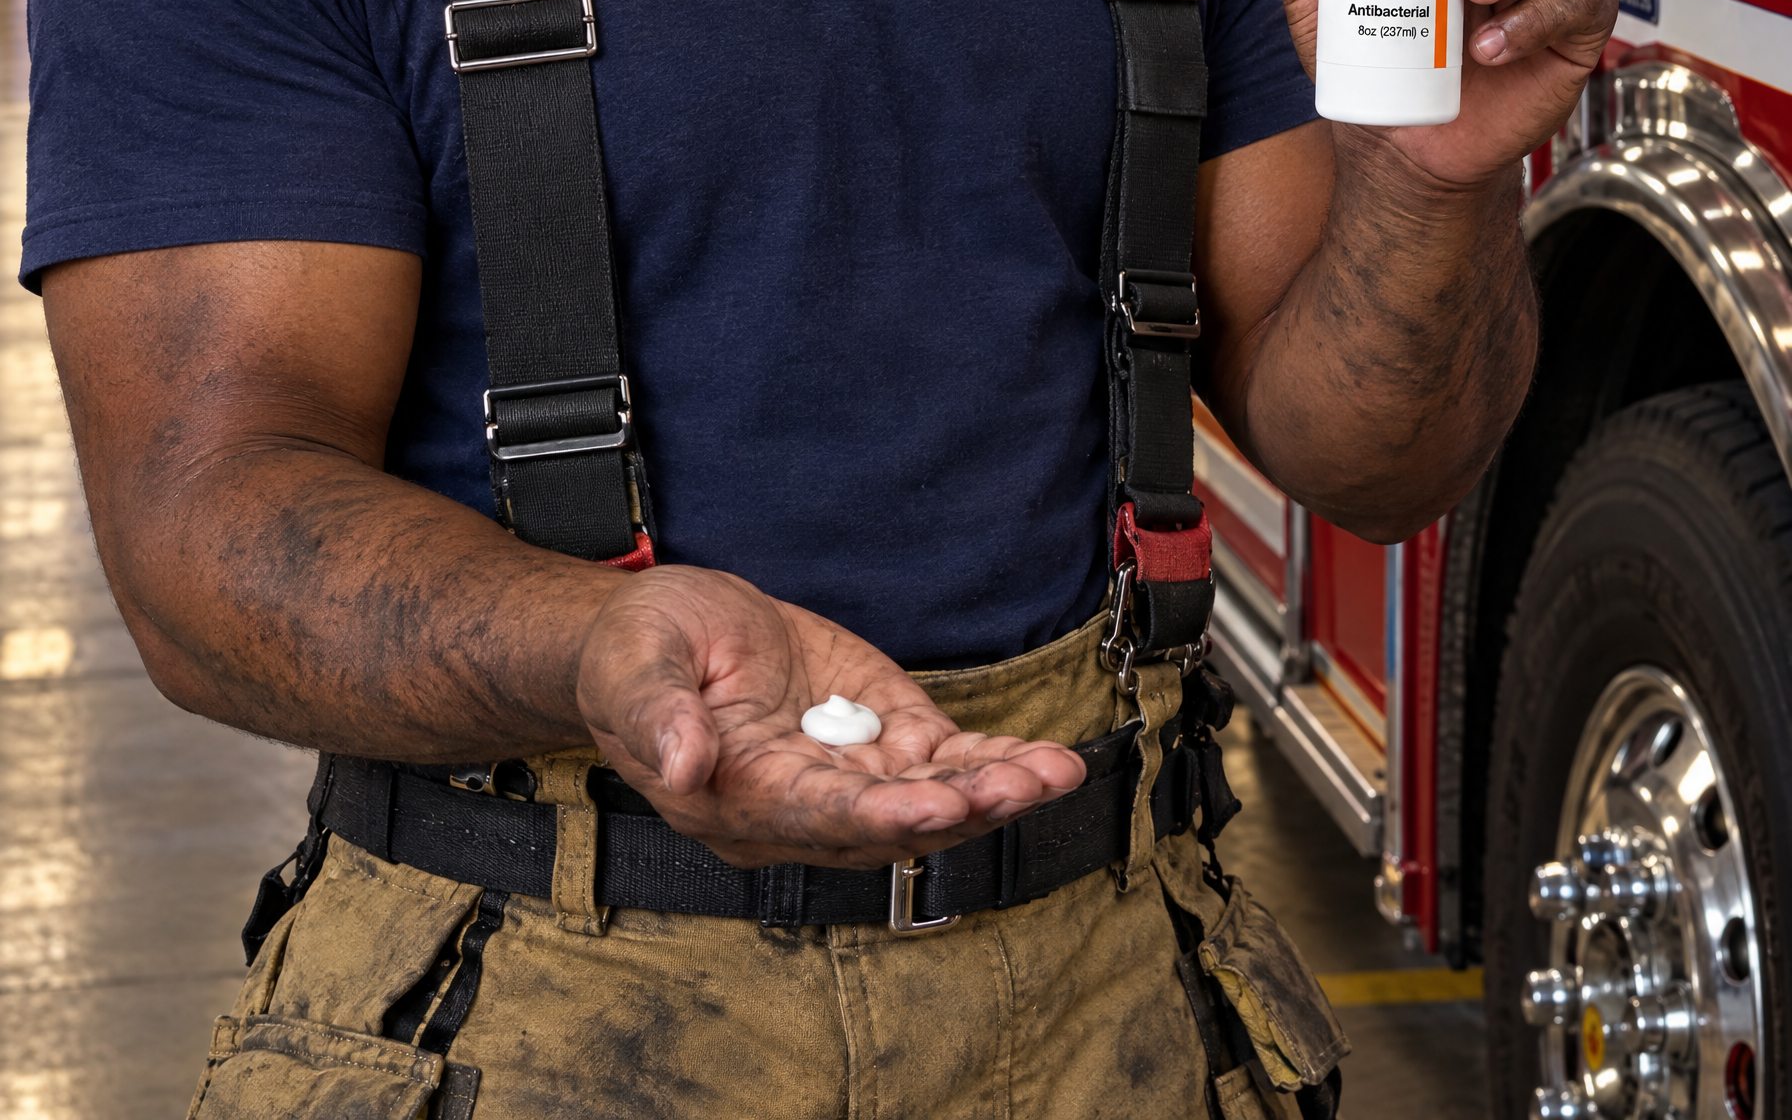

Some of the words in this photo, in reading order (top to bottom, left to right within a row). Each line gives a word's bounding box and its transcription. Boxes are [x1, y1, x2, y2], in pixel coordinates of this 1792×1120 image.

[1348, 3, 1430, 18] Antibacterial
[1358, 25, 1377, 37] 8oz
[1380, 26, 1417, 40] (237ml)
